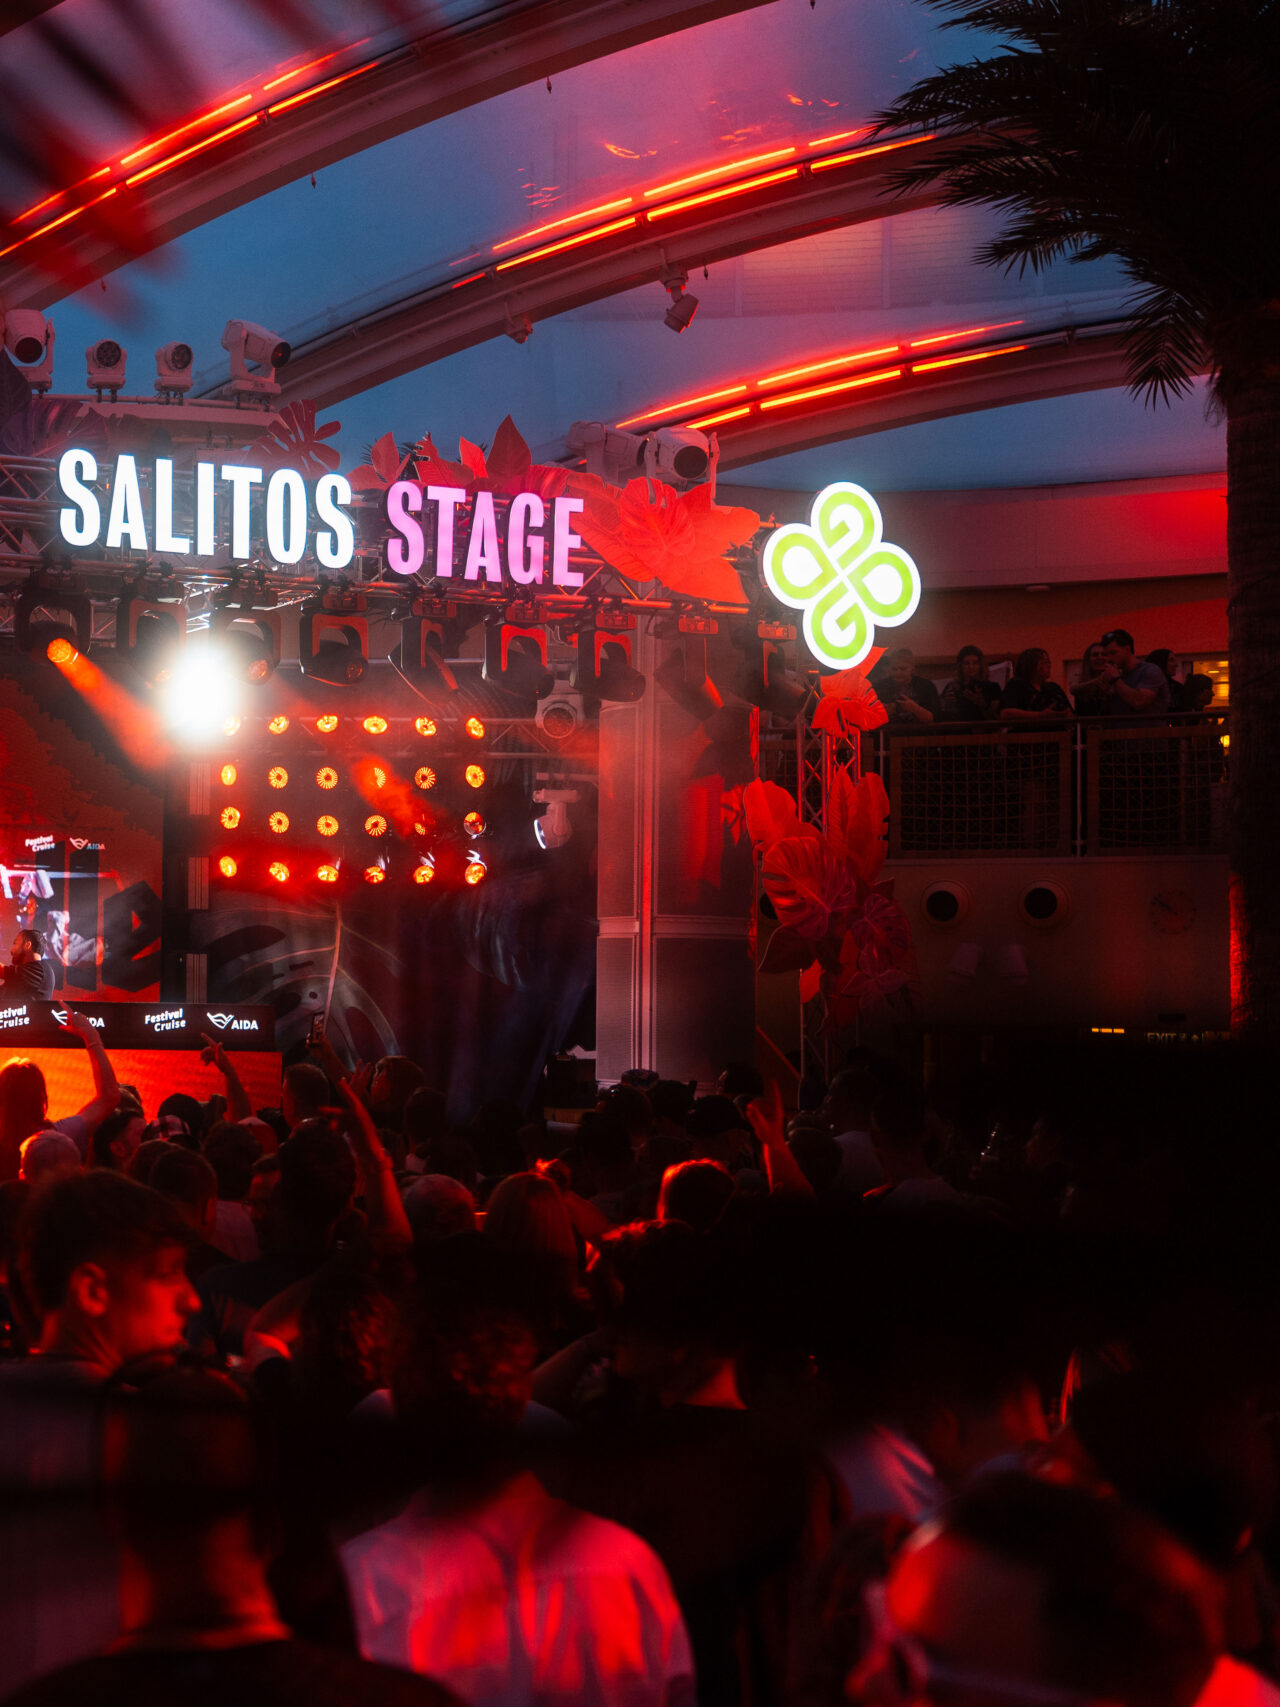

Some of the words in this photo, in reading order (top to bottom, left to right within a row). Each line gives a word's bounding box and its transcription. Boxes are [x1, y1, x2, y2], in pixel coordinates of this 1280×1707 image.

[58, 448, 355, 569] SALITOS
[387, 480, 584, 587] STAGE
[25, 835, 54, 847] Festival
[32, 841, 55, 852] Cruise
[86, 842, 106, 850] AIDA
[145, 1008, 183, 1025] Festival
[154, 1019, 187, 1032] Cruise
[231, 1019, 259, 1030] AIDA
